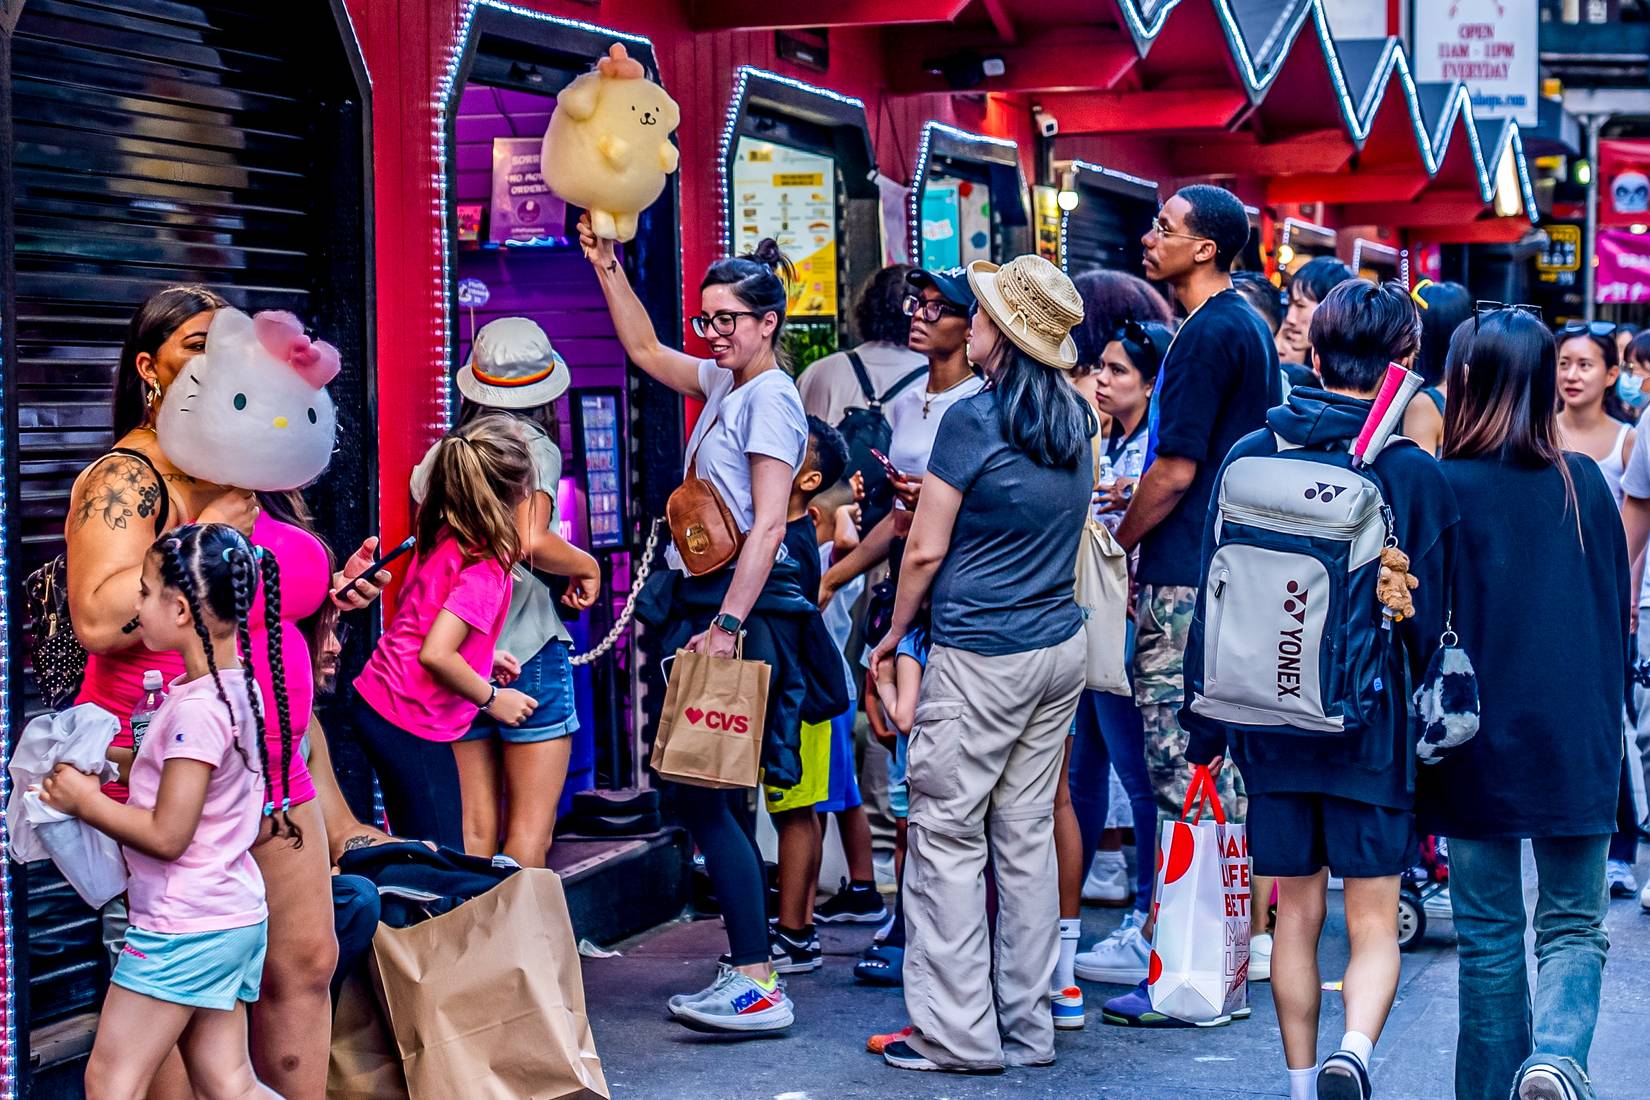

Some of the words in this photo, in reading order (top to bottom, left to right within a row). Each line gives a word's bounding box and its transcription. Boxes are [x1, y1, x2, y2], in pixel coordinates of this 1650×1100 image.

[1458, 23, 1494, 38] OPEN
[1442, 62, 1509, 79] EVERYDAY
[509, 173, 523, 183] NO
[1277, 627, 1304, 699] YONEX
[705, 710, 749, 734] CVS
[730, 988, 765, 1015] HOKA
